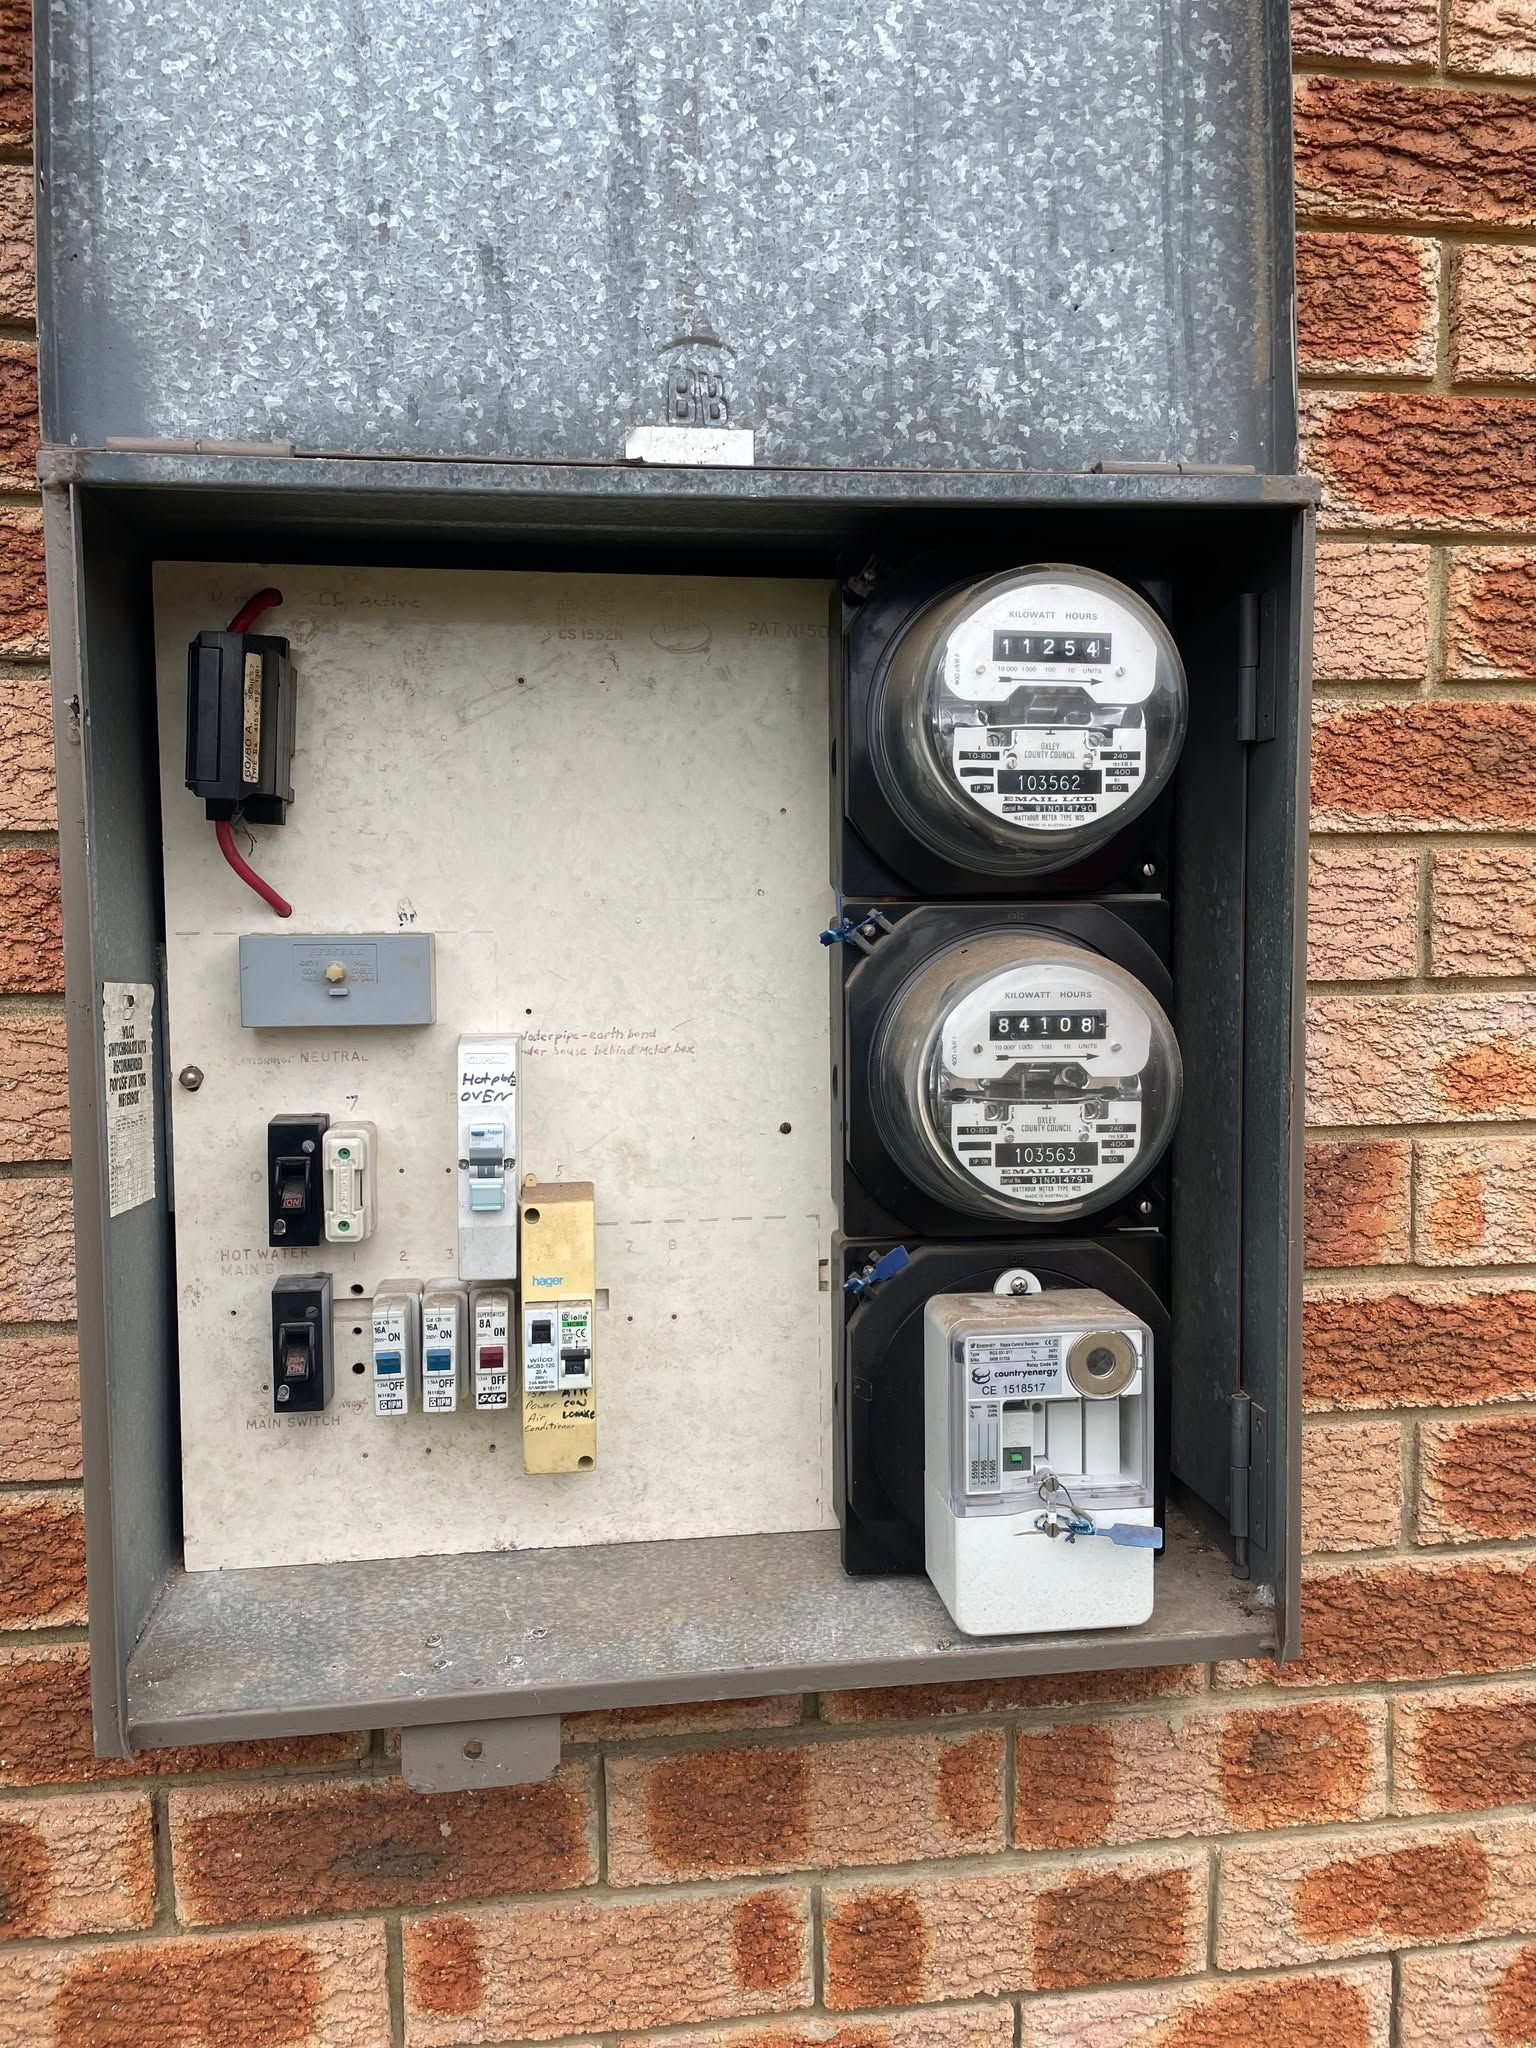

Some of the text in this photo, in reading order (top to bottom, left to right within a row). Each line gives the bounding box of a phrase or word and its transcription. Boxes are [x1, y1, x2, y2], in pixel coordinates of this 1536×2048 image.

[1008, 610, 1098, 620] KILOWATT HOURS
[1040, 742, 1060, 751] OXLEY
[244, 738, 254, 778] 60/80
[967, 752, 992, 760] 10-80
[1024, 750, 1076, 760] COUNTY COUNCIL
[1018, 774, 1081, 791] 103562
[1003, 795, 1058, 803] EMAIL
[1041, 814, 1058, 822] METER
[1004, 991, 1092, 1000] KILOWATT HOURS
[300, 1051, 369, 1063] NEUTRAL
[1037, 1116, 1057, 1124] OXLEY
[1021, 1124, 1072, 1132] COUNTY COUNCIL
[1015, 1147, 1076, 1164] 103563
[1031, 1175, 1088, 1184] 81N014791
[220, 1247, 309, 1261] HOT WATER
[220, 1263, 260, 1276] MAIN
[532, 1276, 564, 1288] hager
[374, 1326, 387, 1334] 16A
[426, 1323, 438, 1331] 16A
[493, 1327, 505, 1337] ON
[388, 1332, 401, 1342] ON
[439, 1330, 452, 1339] ON
[994, 1369, 1058, 1378] countryenergy
[439, 1378, 455, 1388] OFF
[491, 1375, 507, 1385] OFF
[388, 1381, 405, 1391] OFF
[981, 1383, 1046, 1396] CE 1518517
[387, 1400, 402, 1409] HPM
[437, 1397, 452, 1406] HPM
[528, 1412, 546, 1423] Air
[246, 1415, 341, 1431] MAIN SWITCH
